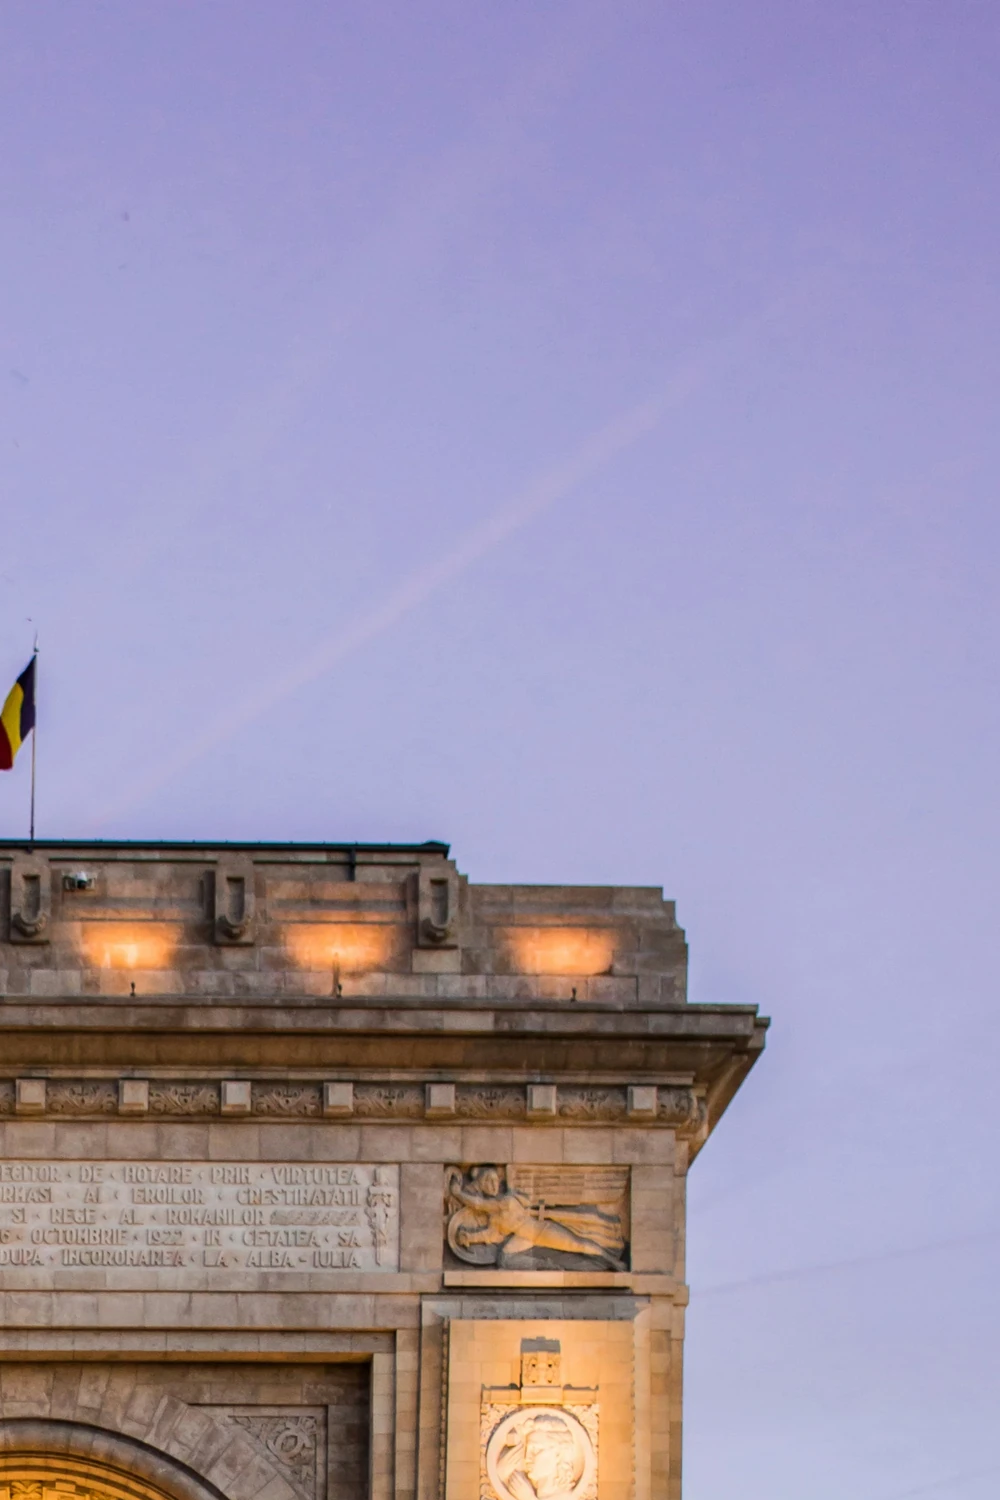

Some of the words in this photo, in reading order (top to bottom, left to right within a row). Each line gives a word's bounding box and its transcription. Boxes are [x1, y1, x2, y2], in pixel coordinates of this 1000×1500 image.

[79, 1165, 104, 1183] DE
[123, 1166, 192, 1184] HOTARE
[211, 1166, 252, 1185] PRIN
[271, 1167, 361, 1185] VIRTUTEA
[84, 1187, 102, 1204] AI
[132, 1187, 205, 1205] EROILOR
[50, 1208, 96, 1225] REGE
[119, 1208, 144, 1225] AL
[166, 1209, 267, 1226] ROMANILOR
[30, 1228, 128, 1245] OCTOMBRIE
[146, 1228, 185, 1246] 1922
[204, 1229, 222, 1246] IN
[242, 1230, 320, 1247] CETATEA
[337, 1230, 361, 1247] SA
[61, 1249, 187, 1267] INCORONAREA
[203, 1250, 228, 1267] LA
